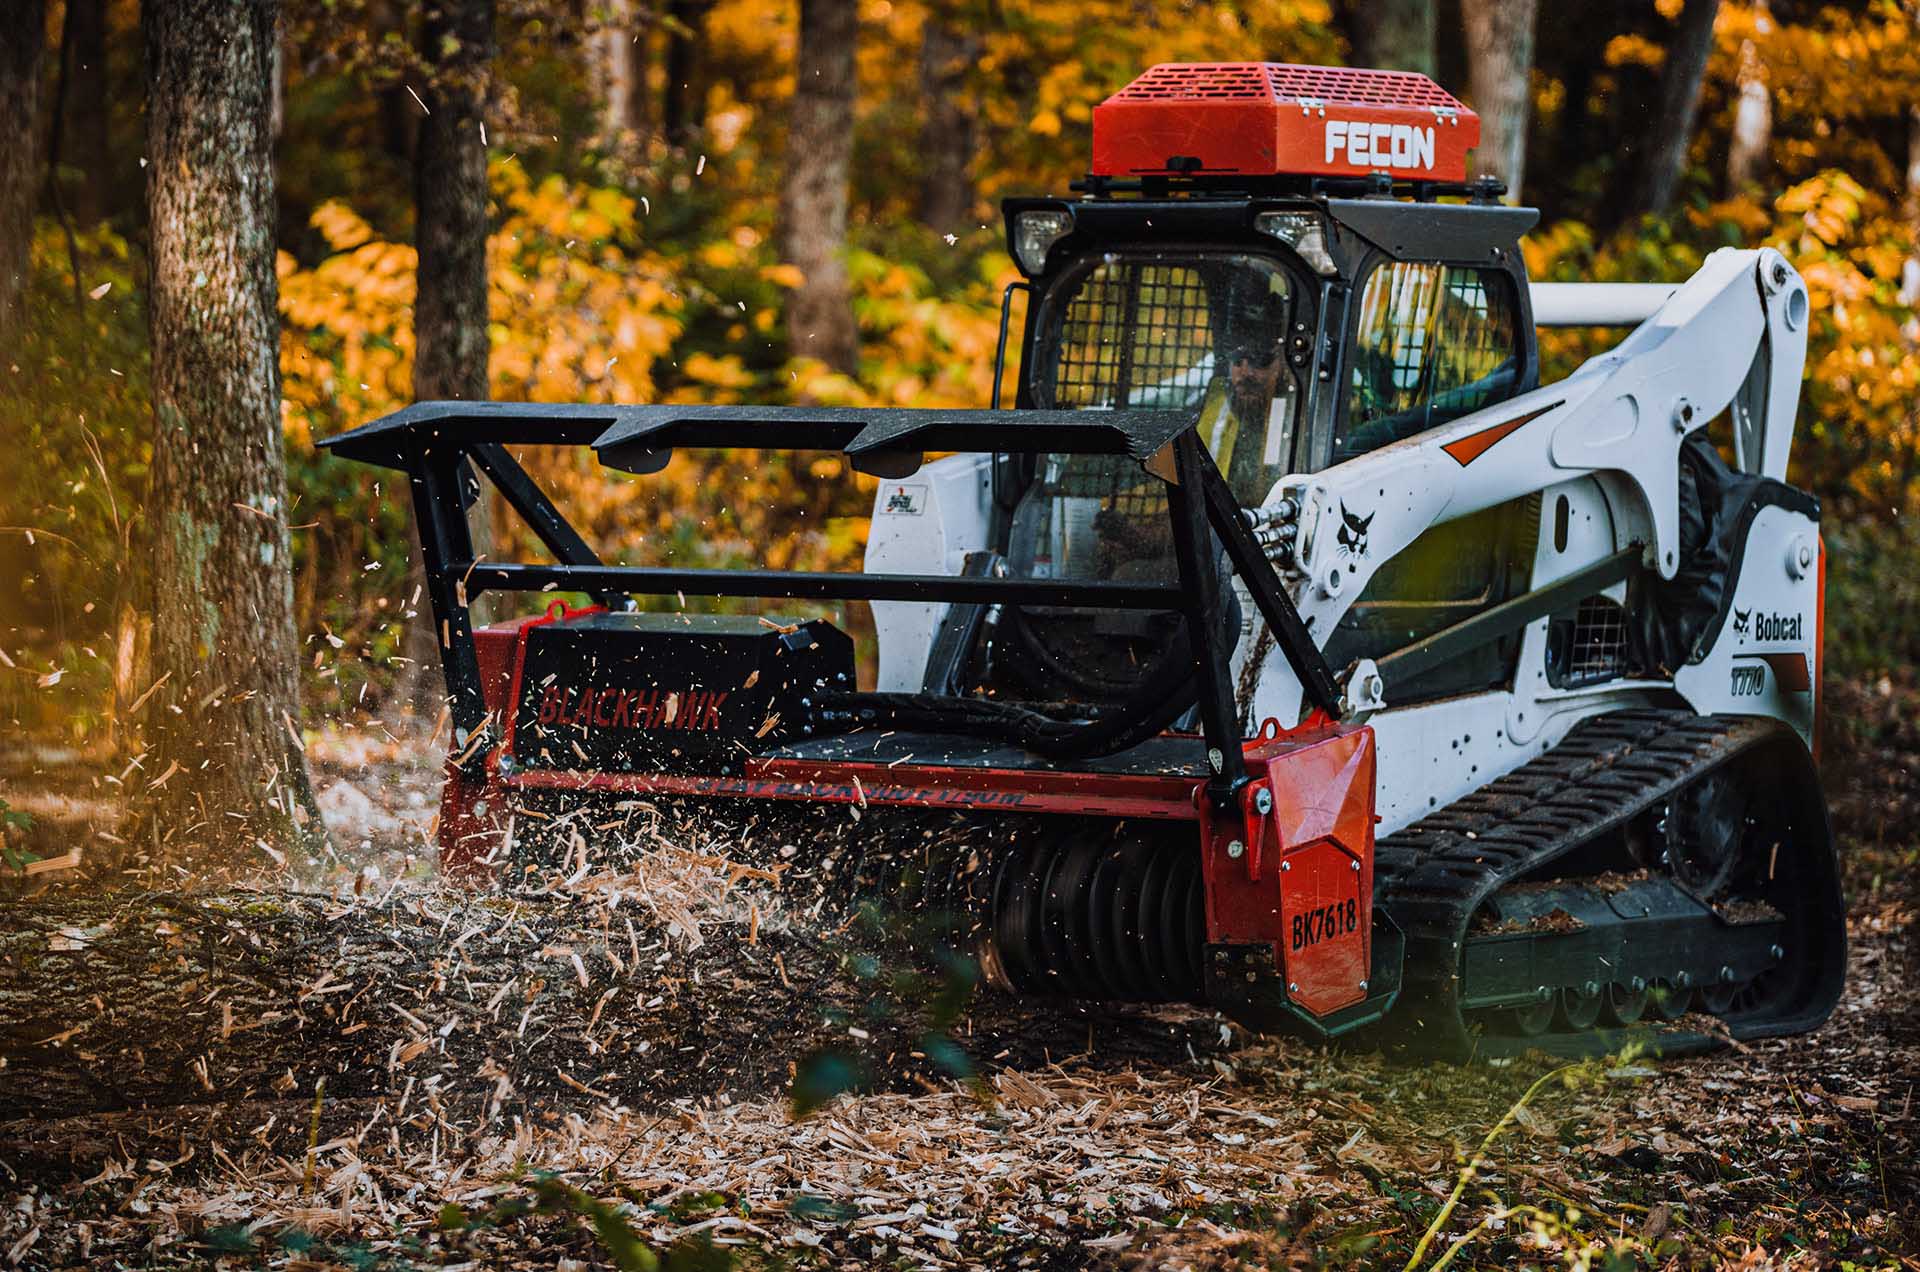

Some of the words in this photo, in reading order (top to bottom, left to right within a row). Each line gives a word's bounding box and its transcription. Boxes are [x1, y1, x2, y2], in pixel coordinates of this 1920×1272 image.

[1325, 120, 1434, 170] FECON
[1755, 612, 1802, 641] Bobcat
[1731, 665, 1765, 697] T770
[1294, 899, 1356, 950] BK7618
